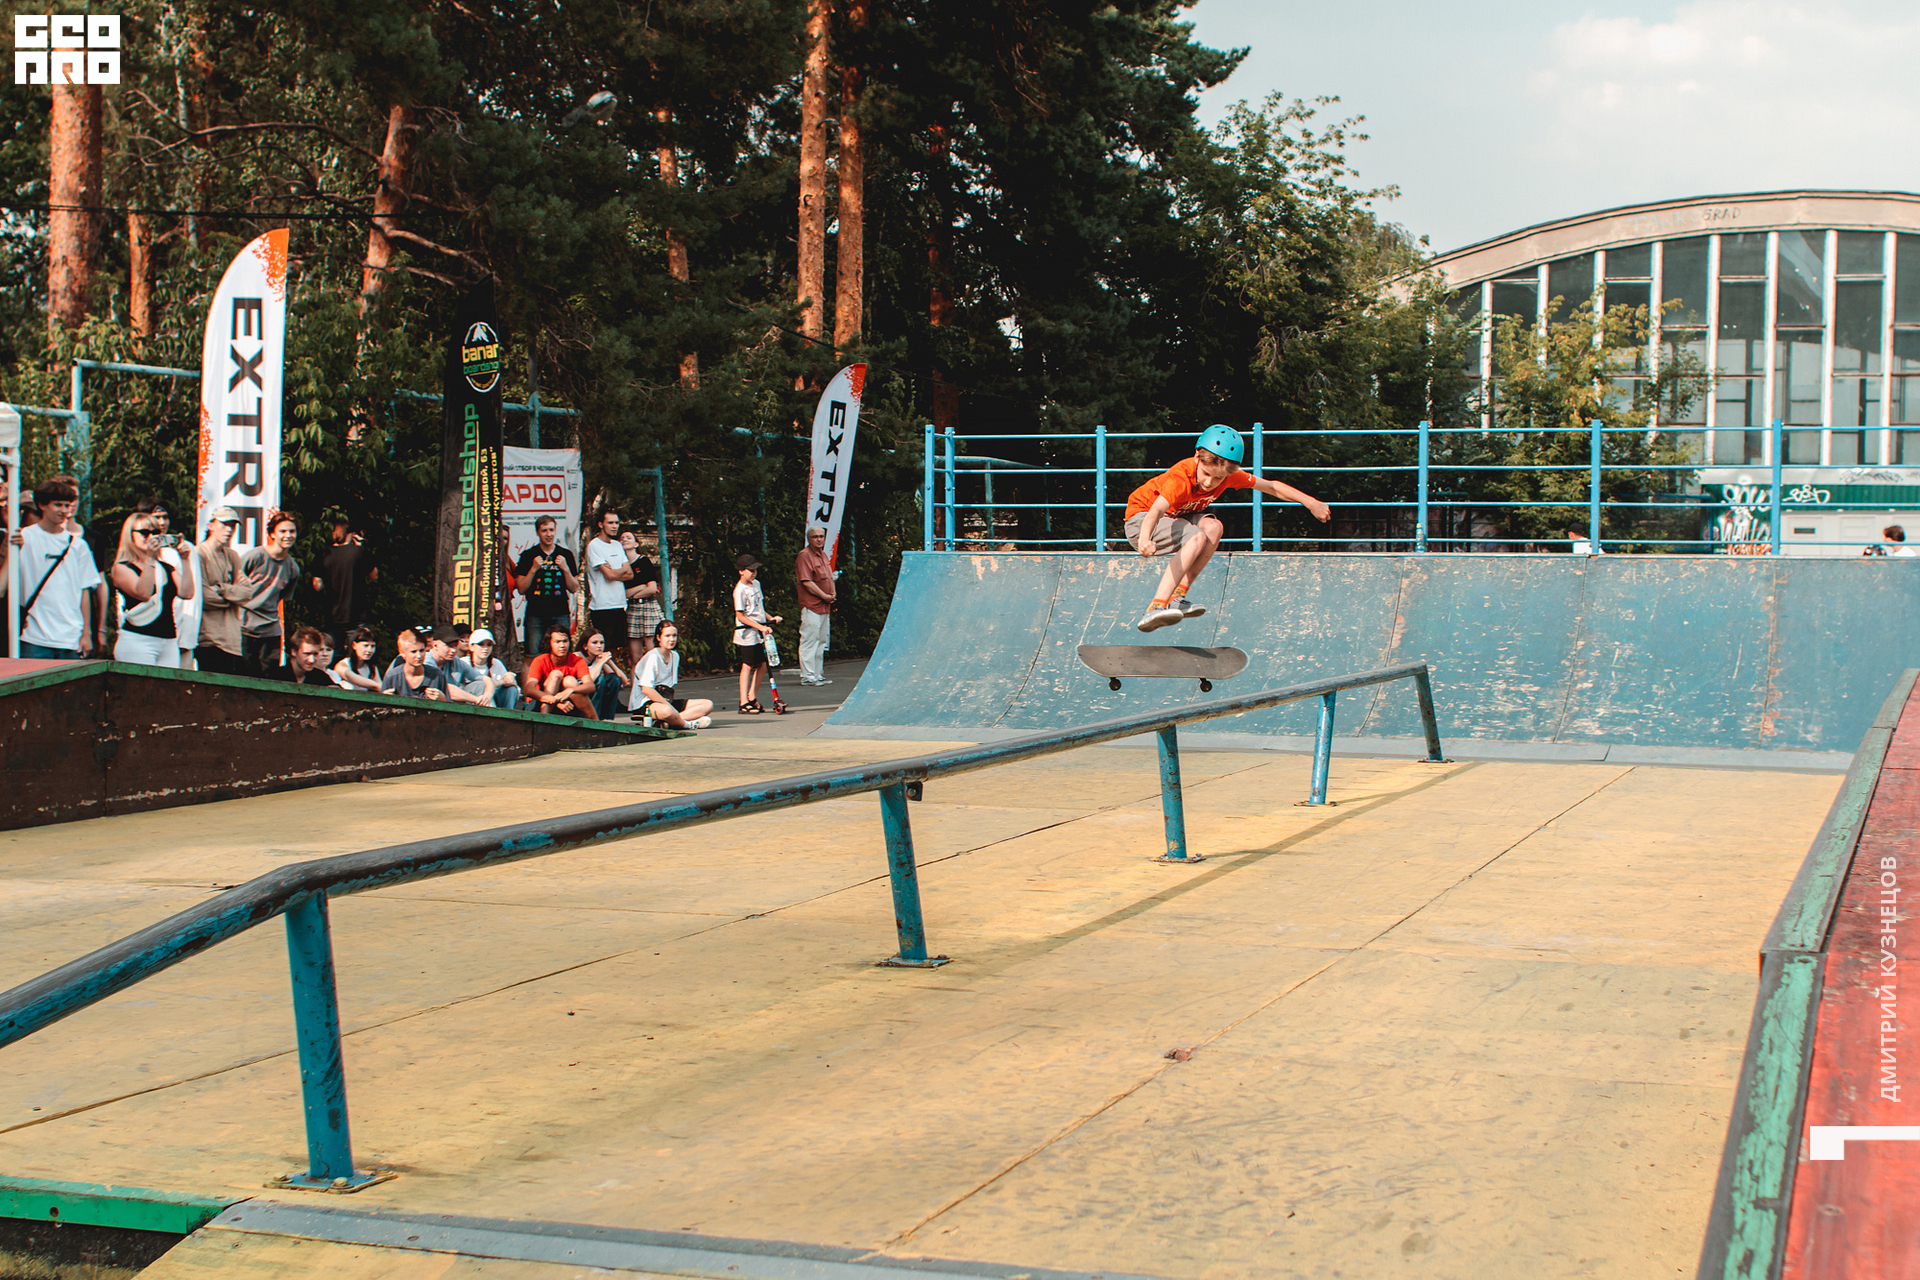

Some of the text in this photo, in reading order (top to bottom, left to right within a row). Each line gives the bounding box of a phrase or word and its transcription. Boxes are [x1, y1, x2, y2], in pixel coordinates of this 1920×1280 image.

[480, 448, 488, 463] 63
[814, 400, 847, 550] EXTR
[483, 528, 494, 547] ул.
[479, 548, 493, 617] Челябинск,
